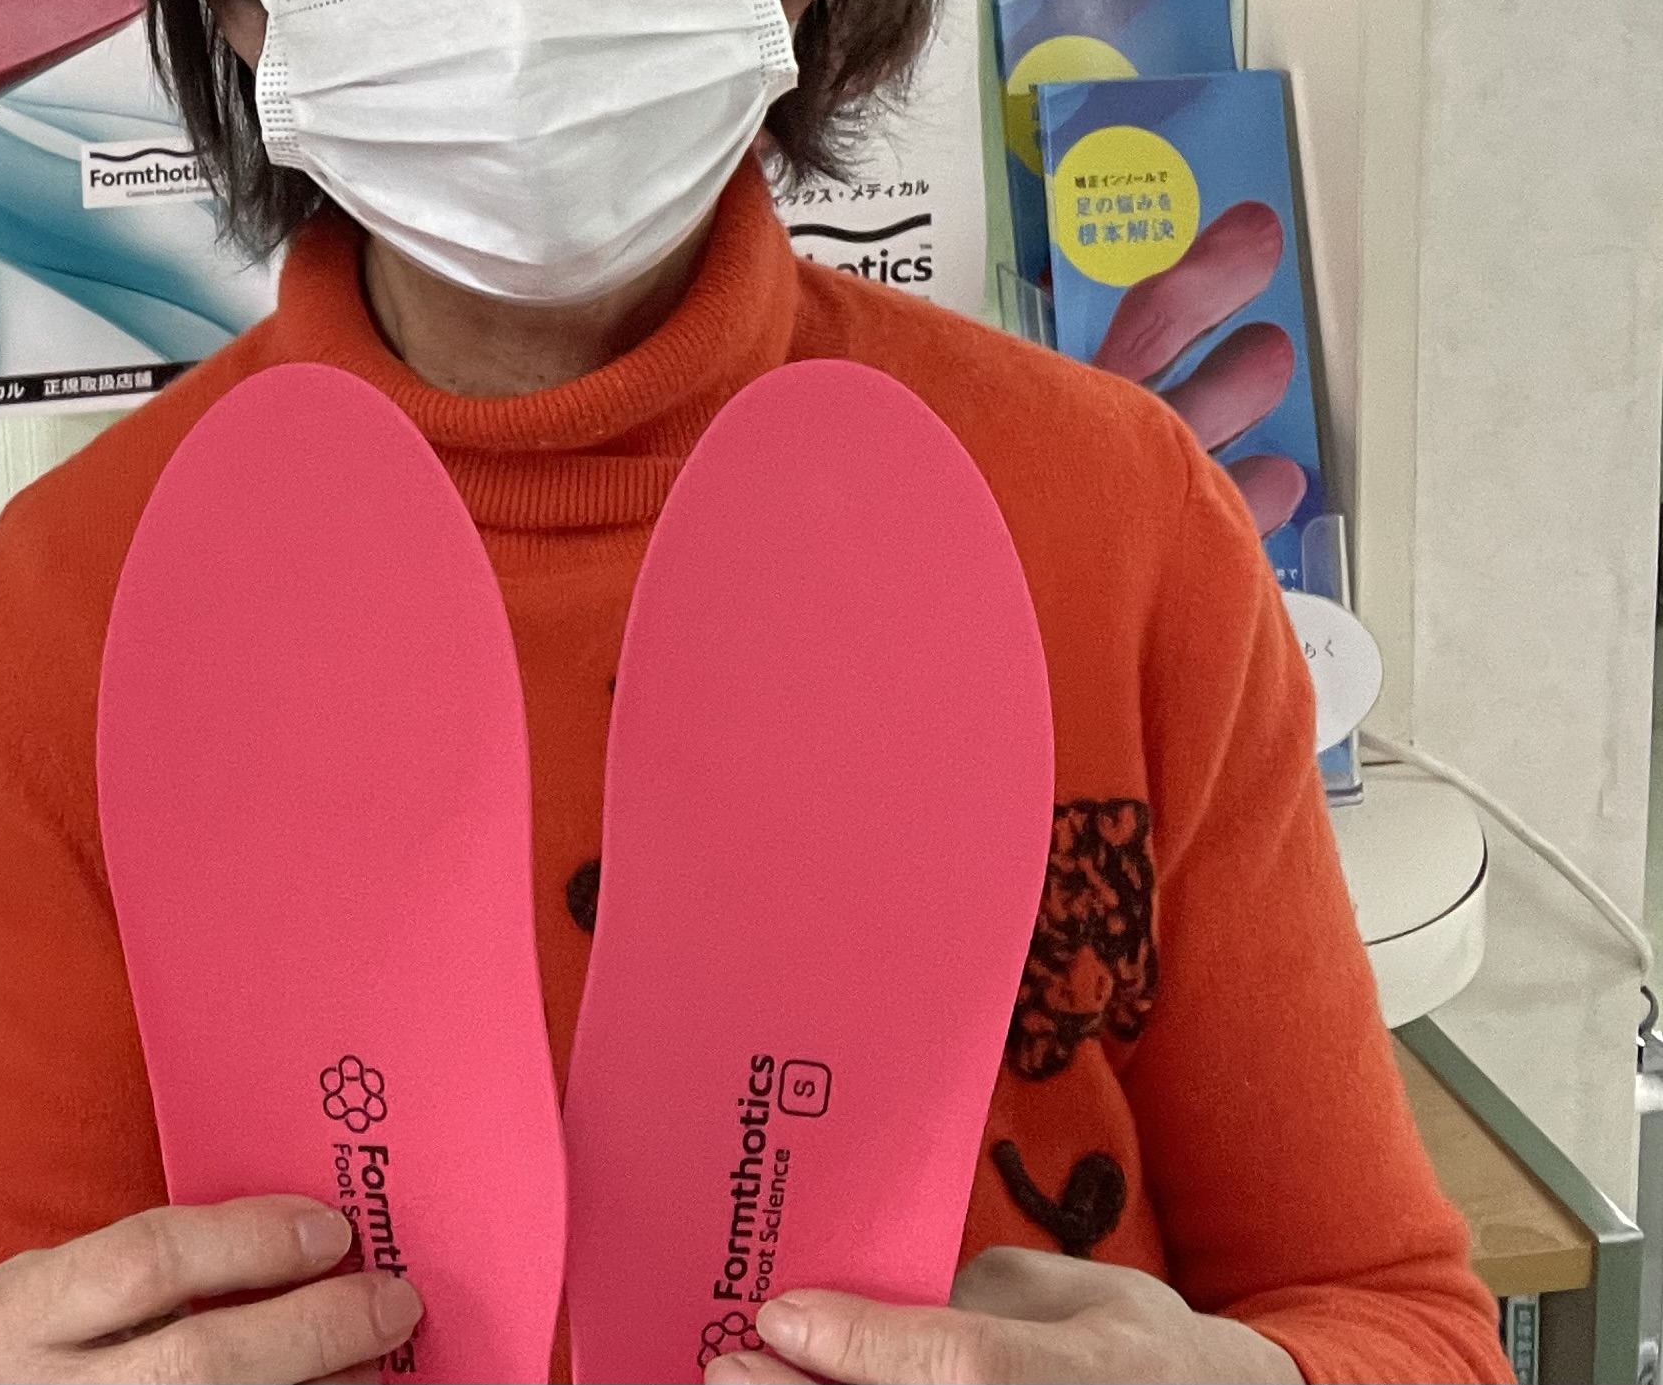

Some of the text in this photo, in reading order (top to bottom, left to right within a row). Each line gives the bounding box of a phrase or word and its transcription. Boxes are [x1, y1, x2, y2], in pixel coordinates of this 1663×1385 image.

[89, 161, 199, 188] Formthoti
[793, 1079, 816, 1098] S
[333, 1143, 357, 1199] Foot
[713, 1053, 776, 1301] Formthotics
[748, 1149, 791, 1303] Foot Science
